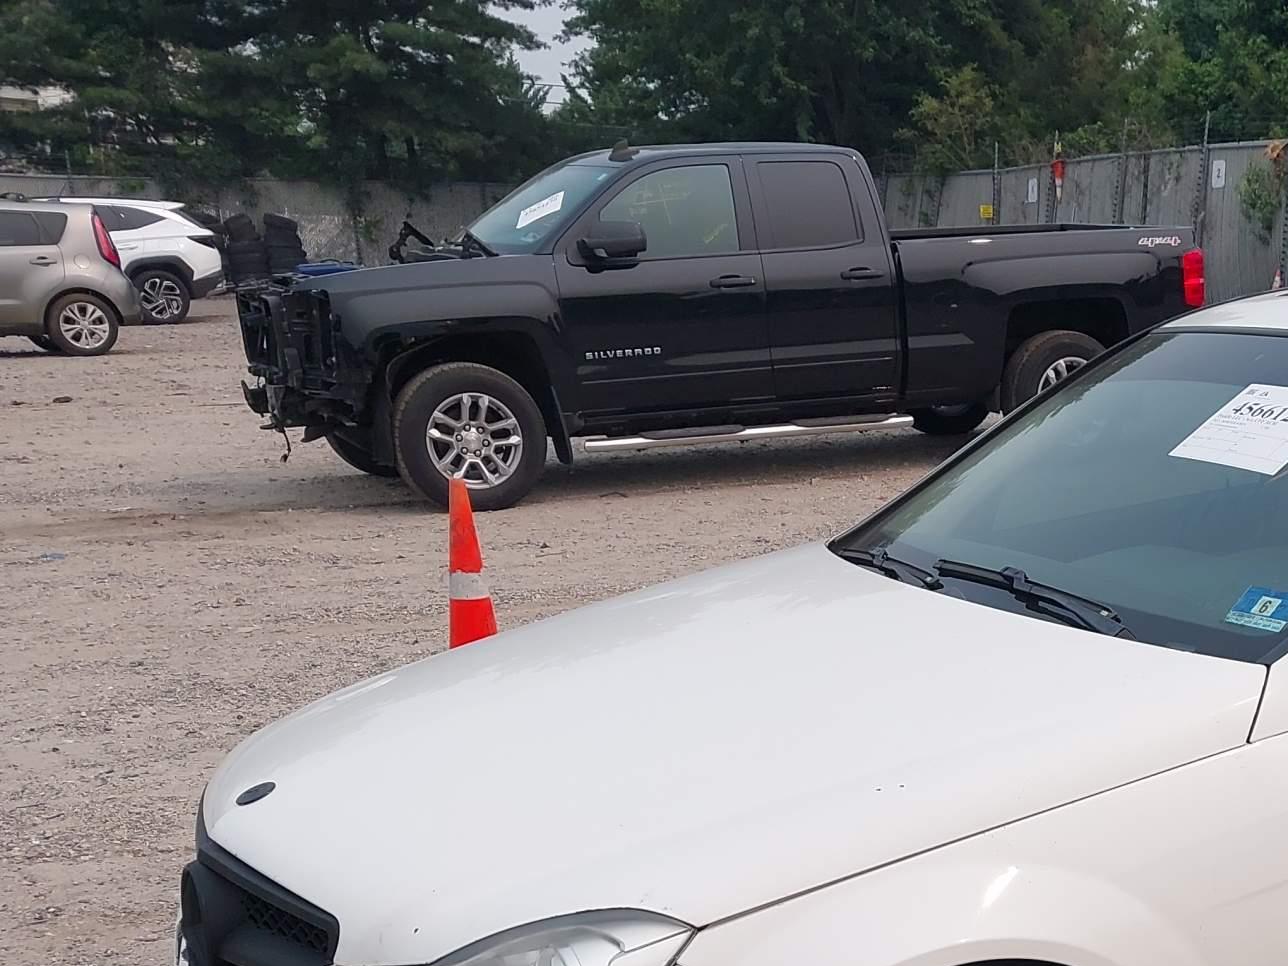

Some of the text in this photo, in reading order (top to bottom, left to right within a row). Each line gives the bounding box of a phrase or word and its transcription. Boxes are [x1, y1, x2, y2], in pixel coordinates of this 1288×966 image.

[1216, 168, 1221, 178] 2
[585, 347, 662, 360] SILVERADO
[1258, 600, 1272, 614] 6
